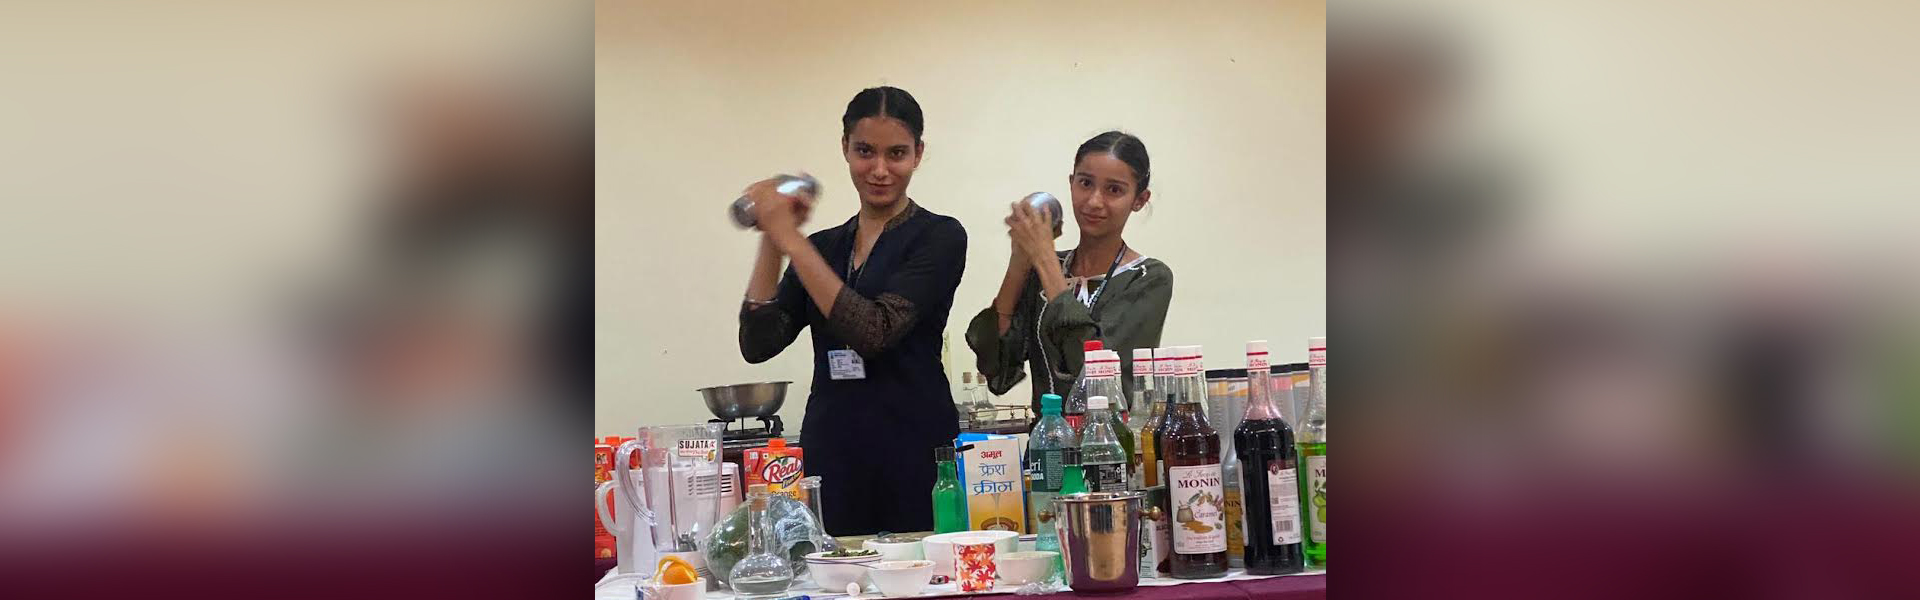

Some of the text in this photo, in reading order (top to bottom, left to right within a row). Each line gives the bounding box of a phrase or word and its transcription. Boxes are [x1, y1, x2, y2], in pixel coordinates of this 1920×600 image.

[680, 440, 708, 449] SUJATA
[981, 450, 1002, 459] अमूल
[768, 458, 799, 484] Real
[979, 462, 1007, 476] फ्रेश
[973, 480, 1014, 496] क्रीम
[1178, 478, 1220, 488] MONIN
